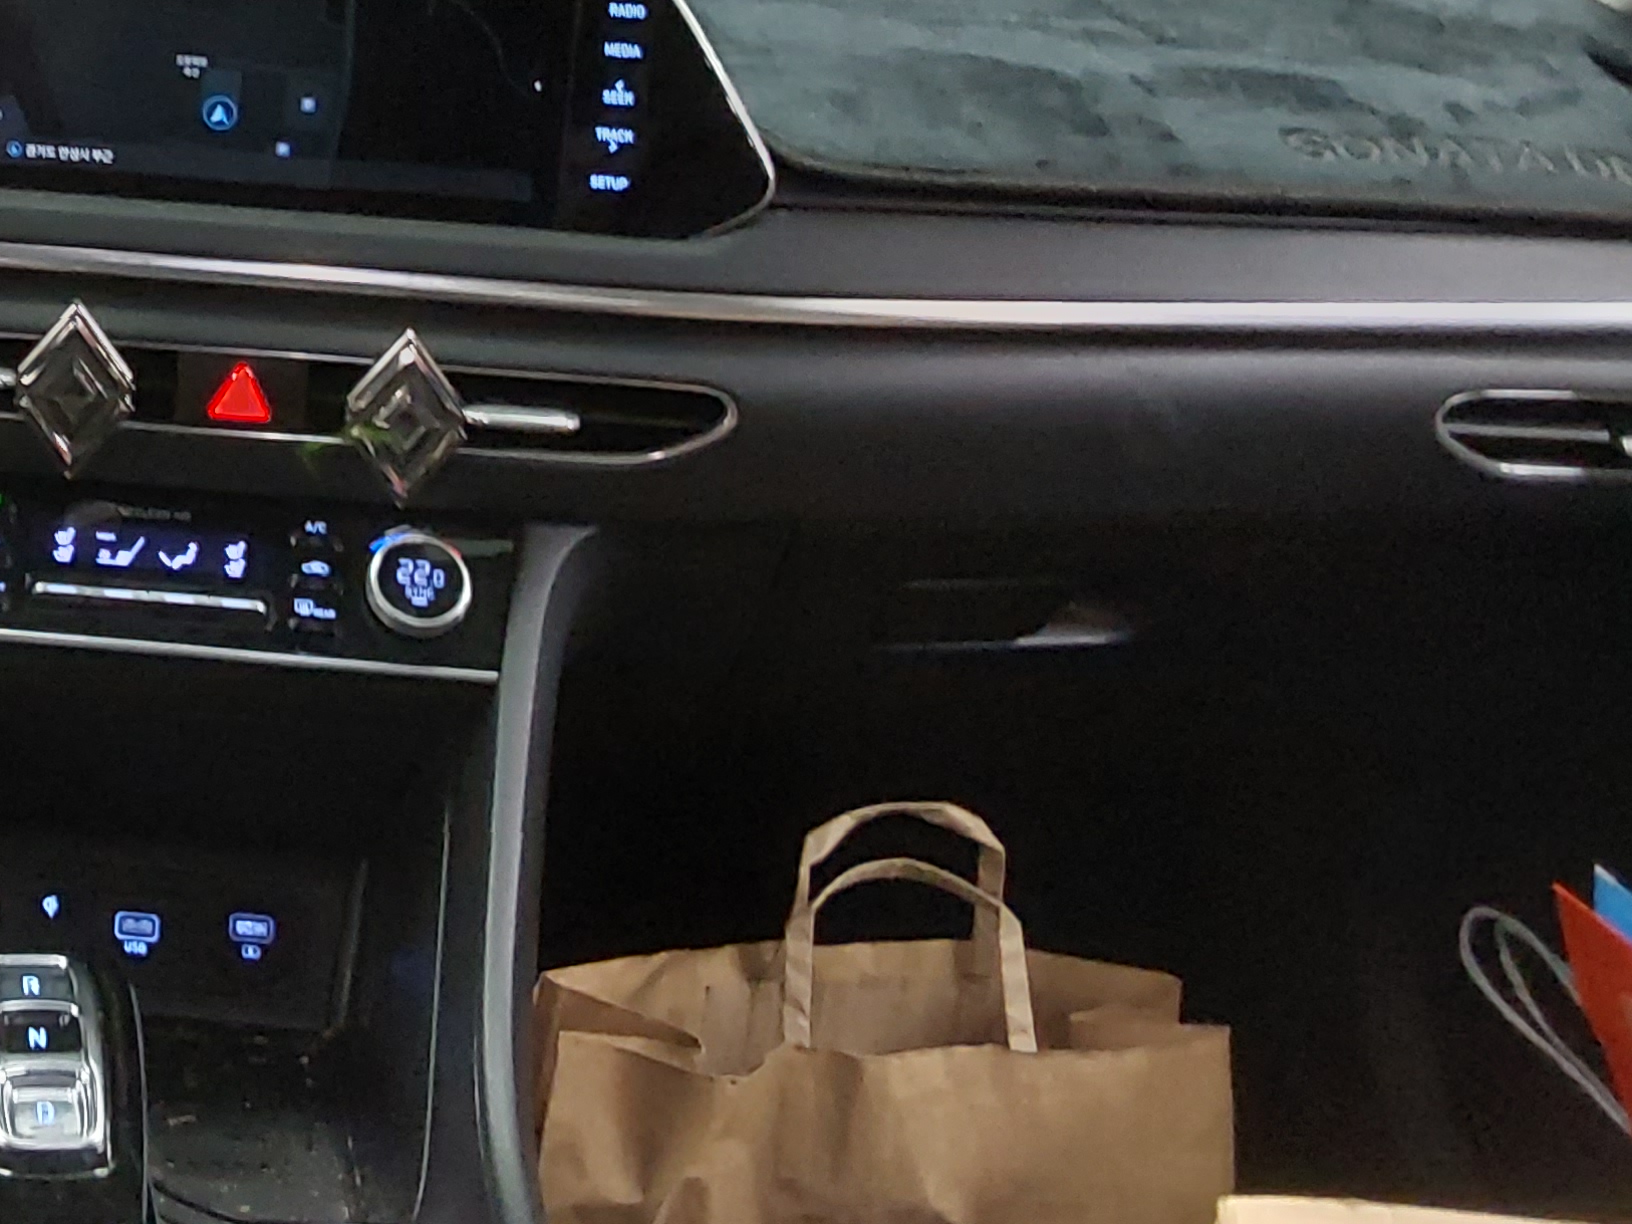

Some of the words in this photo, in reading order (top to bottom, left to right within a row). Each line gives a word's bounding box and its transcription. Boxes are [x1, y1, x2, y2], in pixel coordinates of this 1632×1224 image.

[608, 2, 648, 20] RADIO
[603, 41, 644, 59] MEDIA
[589, 174, 631, 192] SETUP
[21, 976, 41, 996] R
[27, 1026, 48, 1050] N
